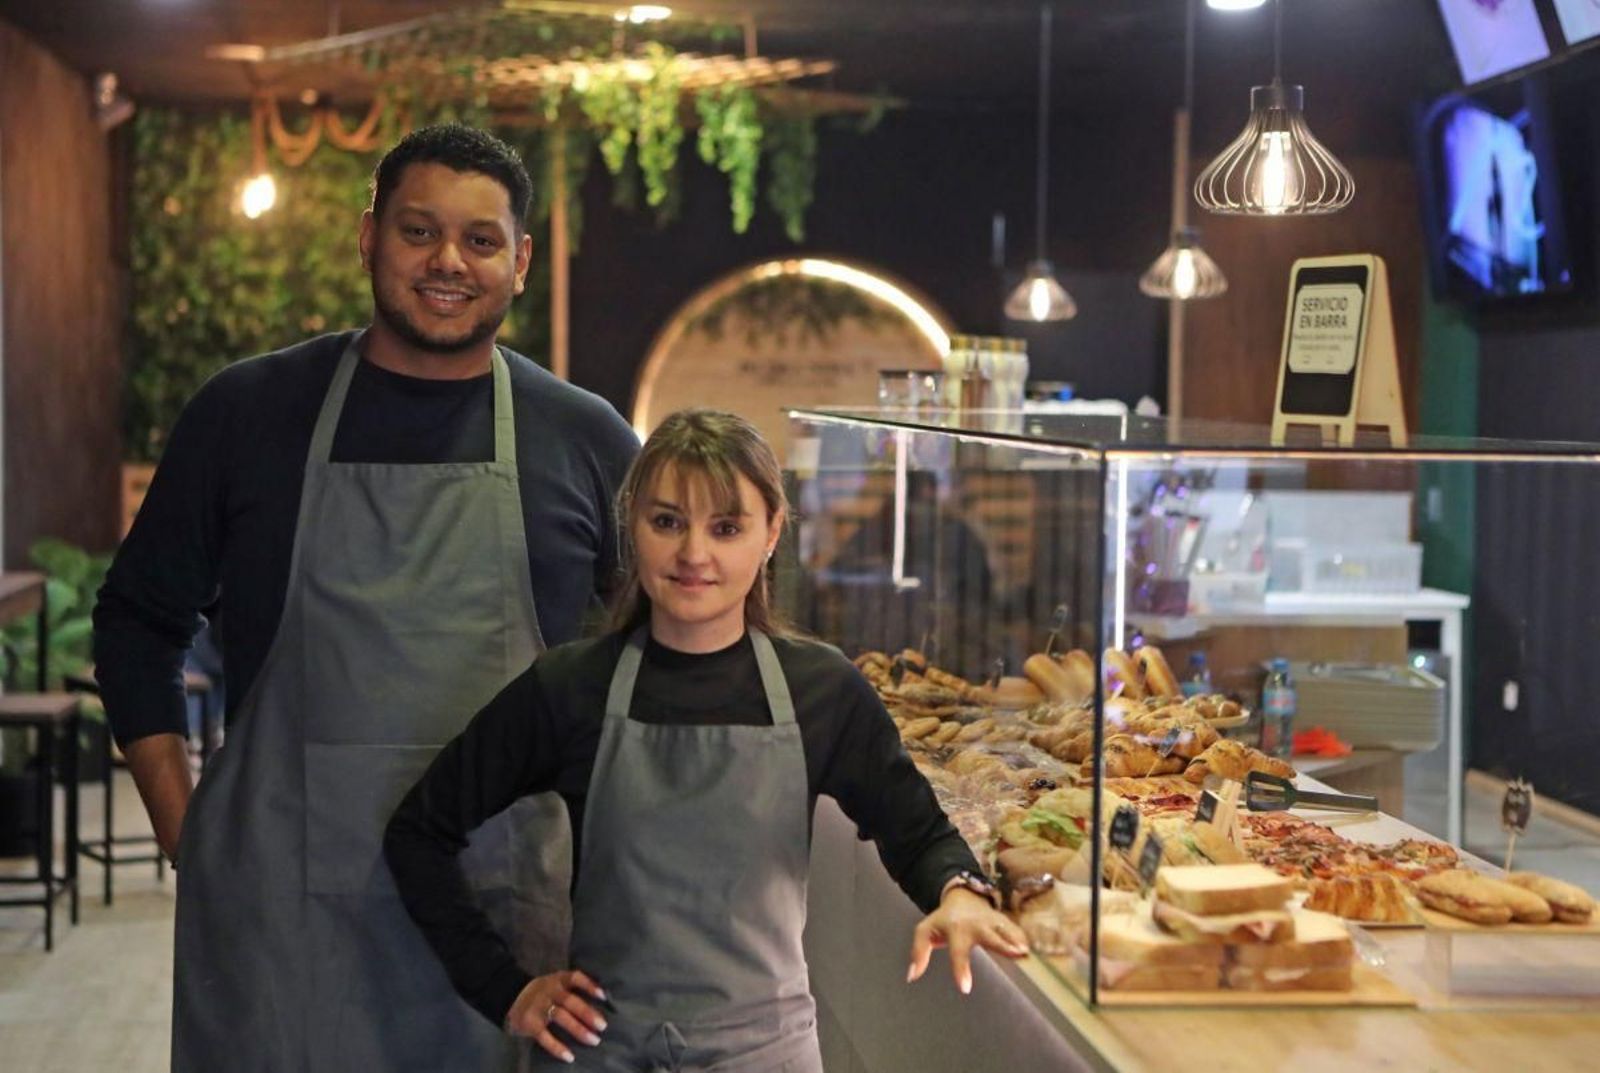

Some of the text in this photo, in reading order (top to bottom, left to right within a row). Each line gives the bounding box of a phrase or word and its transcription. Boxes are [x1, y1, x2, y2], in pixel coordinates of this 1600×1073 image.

[1302, 297, 1348, 312] SERVICIO
[1300, 314, 1347, 329] EN BARRA
